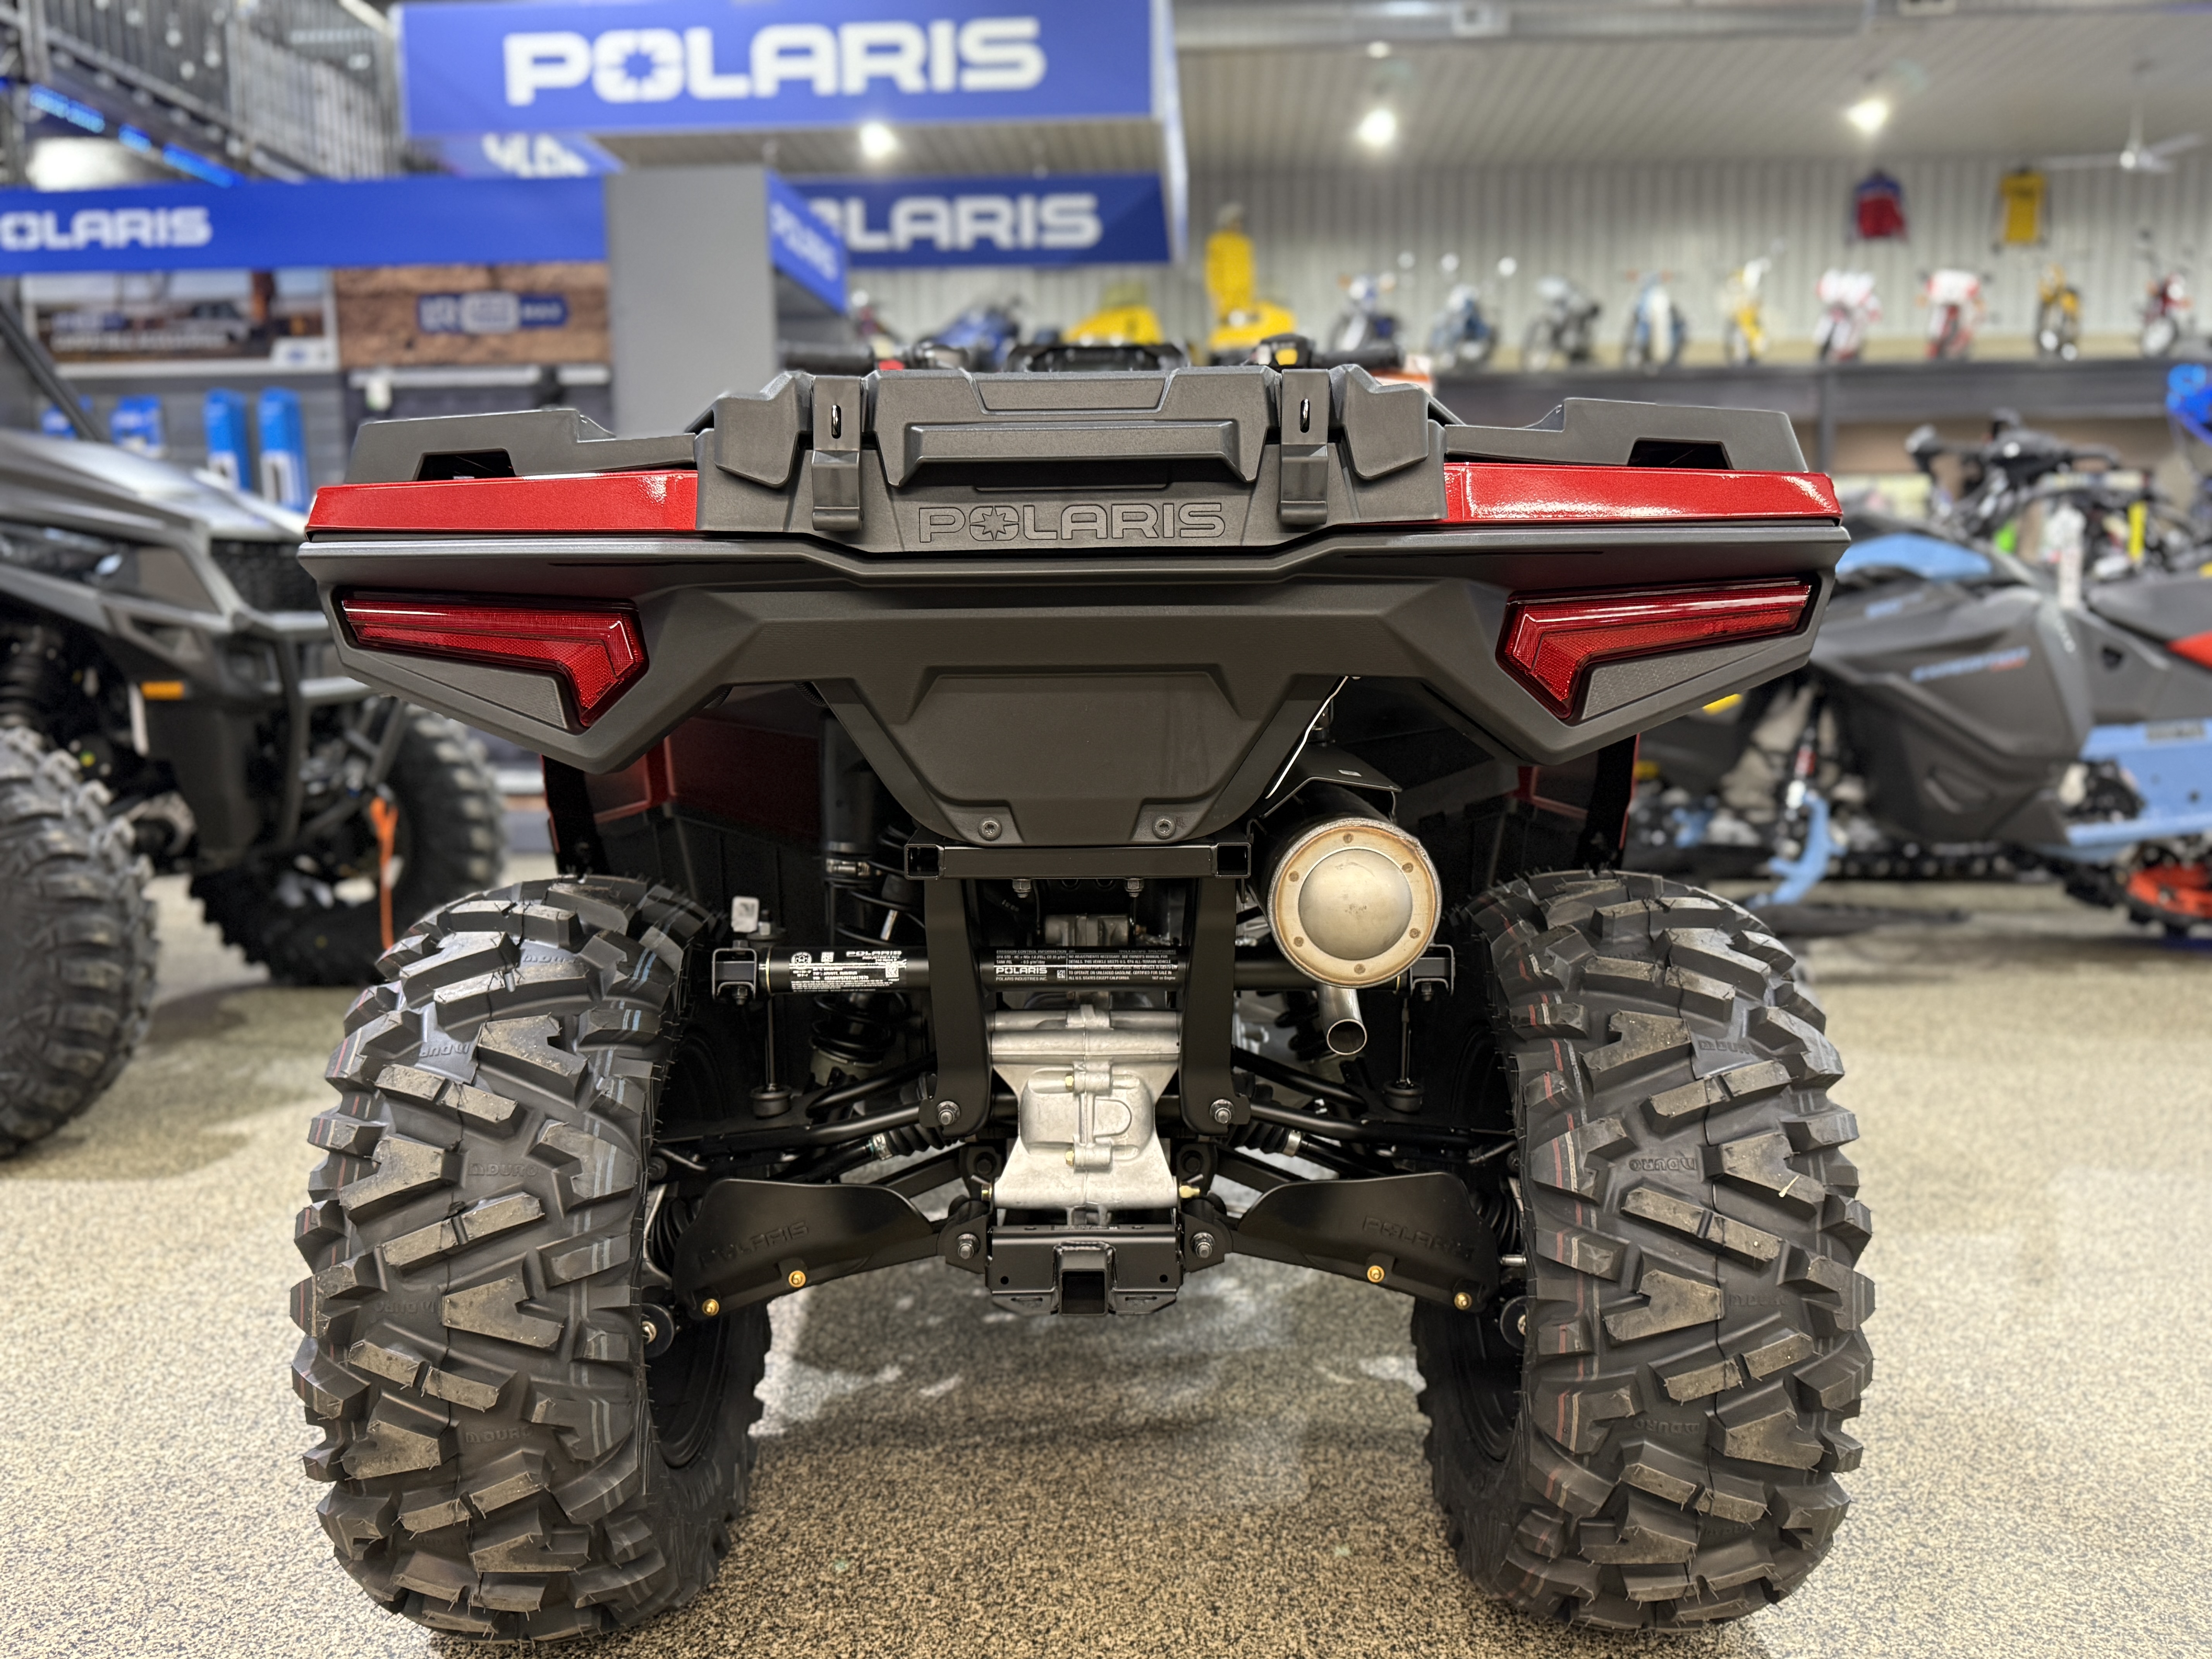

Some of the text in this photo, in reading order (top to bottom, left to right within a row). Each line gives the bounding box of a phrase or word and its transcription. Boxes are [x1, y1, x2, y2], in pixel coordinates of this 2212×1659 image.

[503, 16, 1048, 106] POLARIS
[0, 207, 212, 251] OLARIS
[919, 503, 1225, 542] POLARIS
[1362, 1215, 1475, 1259] POLAR
